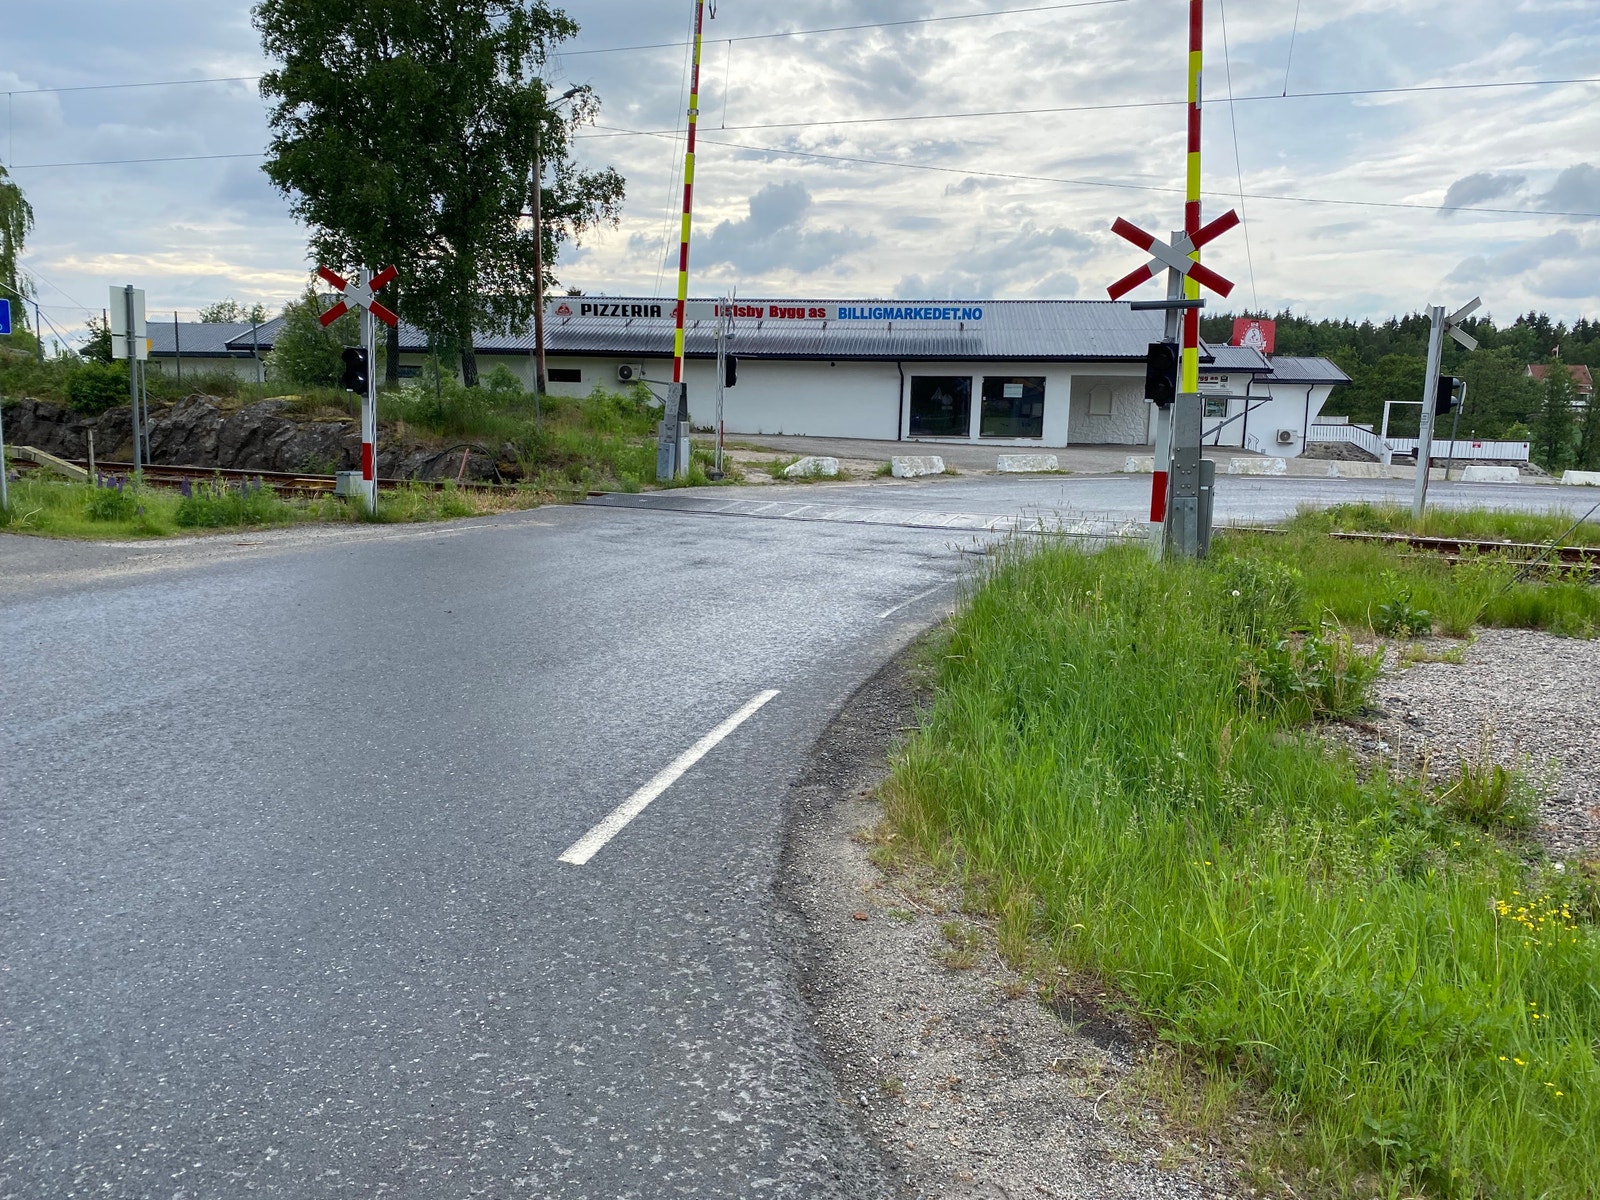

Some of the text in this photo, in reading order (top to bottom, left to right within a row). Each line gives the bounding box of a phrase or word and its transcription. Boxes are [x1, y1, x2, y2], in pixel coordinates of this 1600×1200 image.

[580, 303, 662, 318] PIZZERIA
[769, 305, 806, 320] Bygg
[808, 307, 826, 318] as
[838, 307, 983, 320] BILLIGMARKEDET.NO
